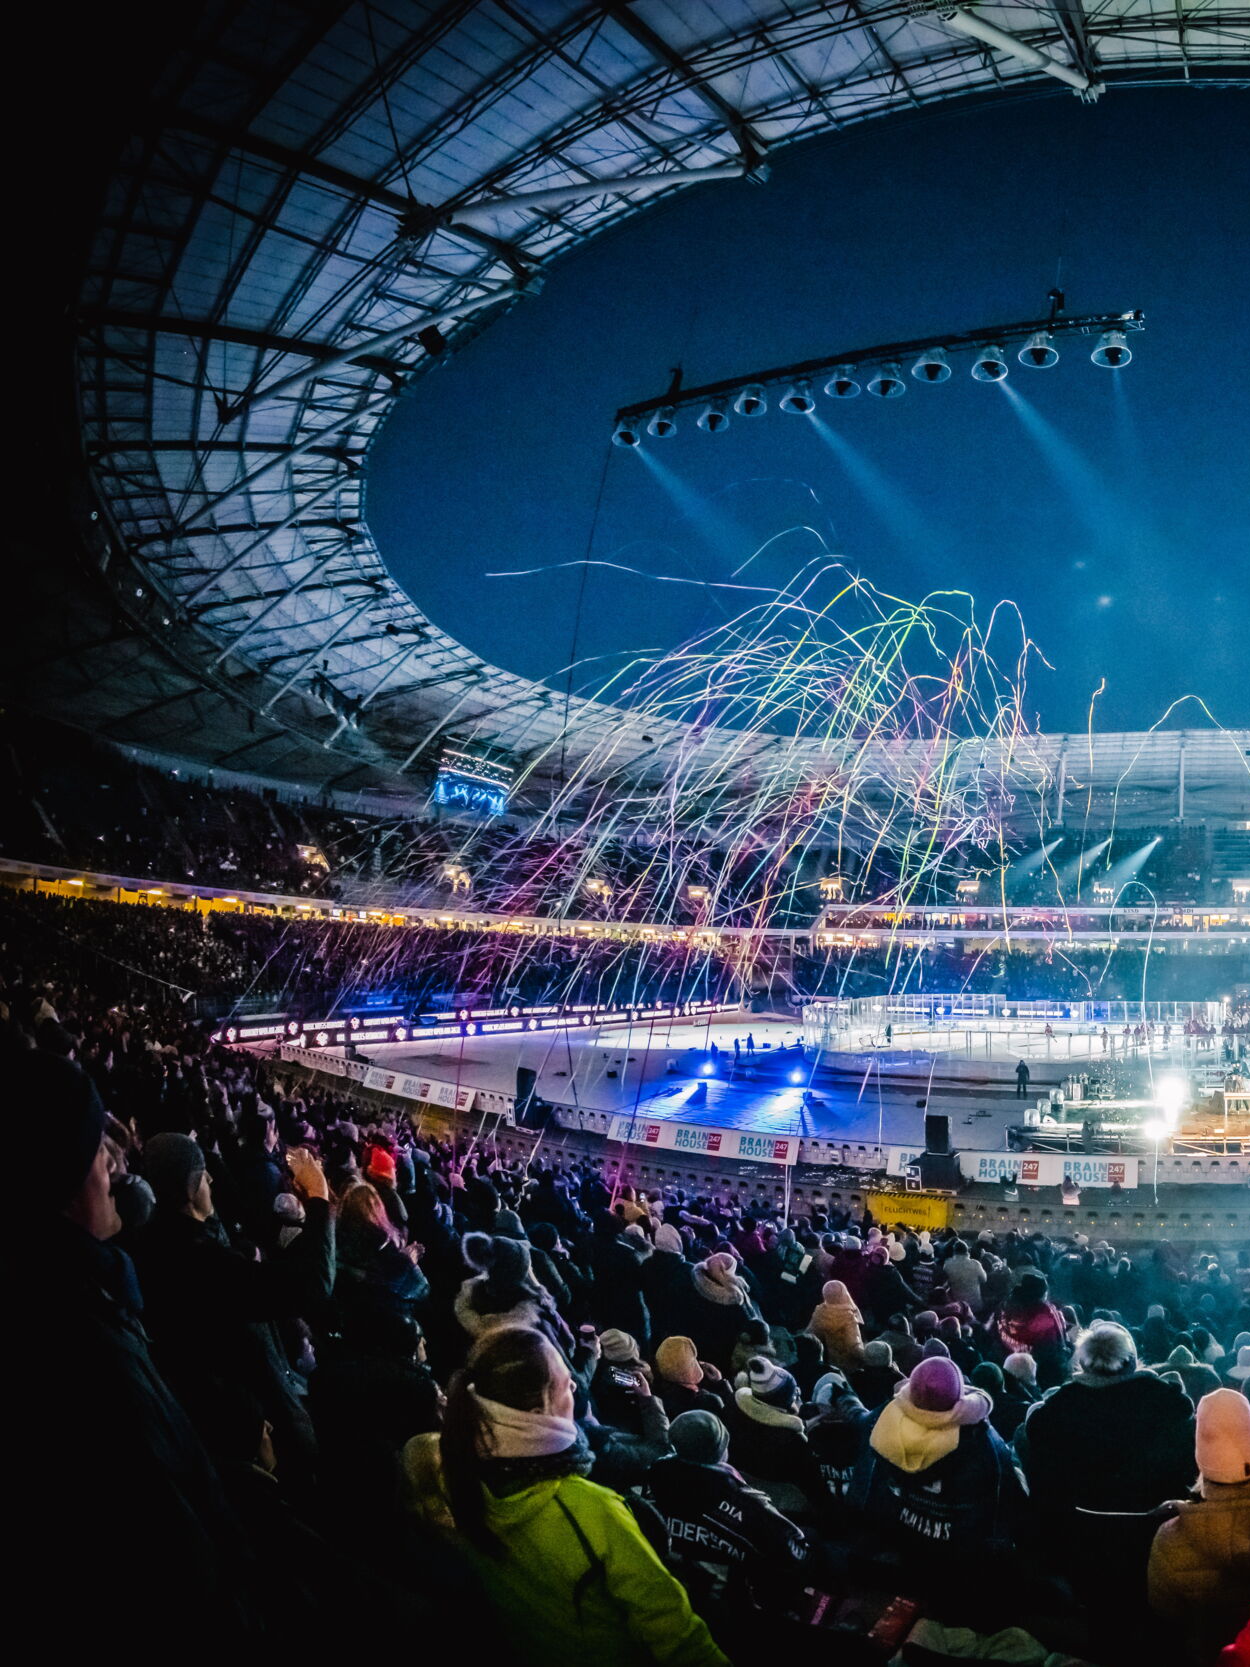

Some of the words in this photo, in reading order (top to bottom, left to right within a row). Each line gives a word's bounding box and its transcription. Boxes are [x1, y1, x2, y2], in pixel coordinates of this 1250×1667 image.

[676, 1128, 708, 1141] BRAIN
[709, 1134, 721, 1143] 247
[674, 1138, 707, 1150] HOUSE
[740, 1136, 774, 1149] BRAIN
[775, 1142, 788, 1151] 247
[738, 1146, 773, 1158] HOUSE
[979, 1158, 1022, 1170] BRAIN
[1023, 1162, 1038, 1170] 247
[1063, 1161, 1108, 1173] BRAIN
[1108, 1165, 1124, 1173] 247
